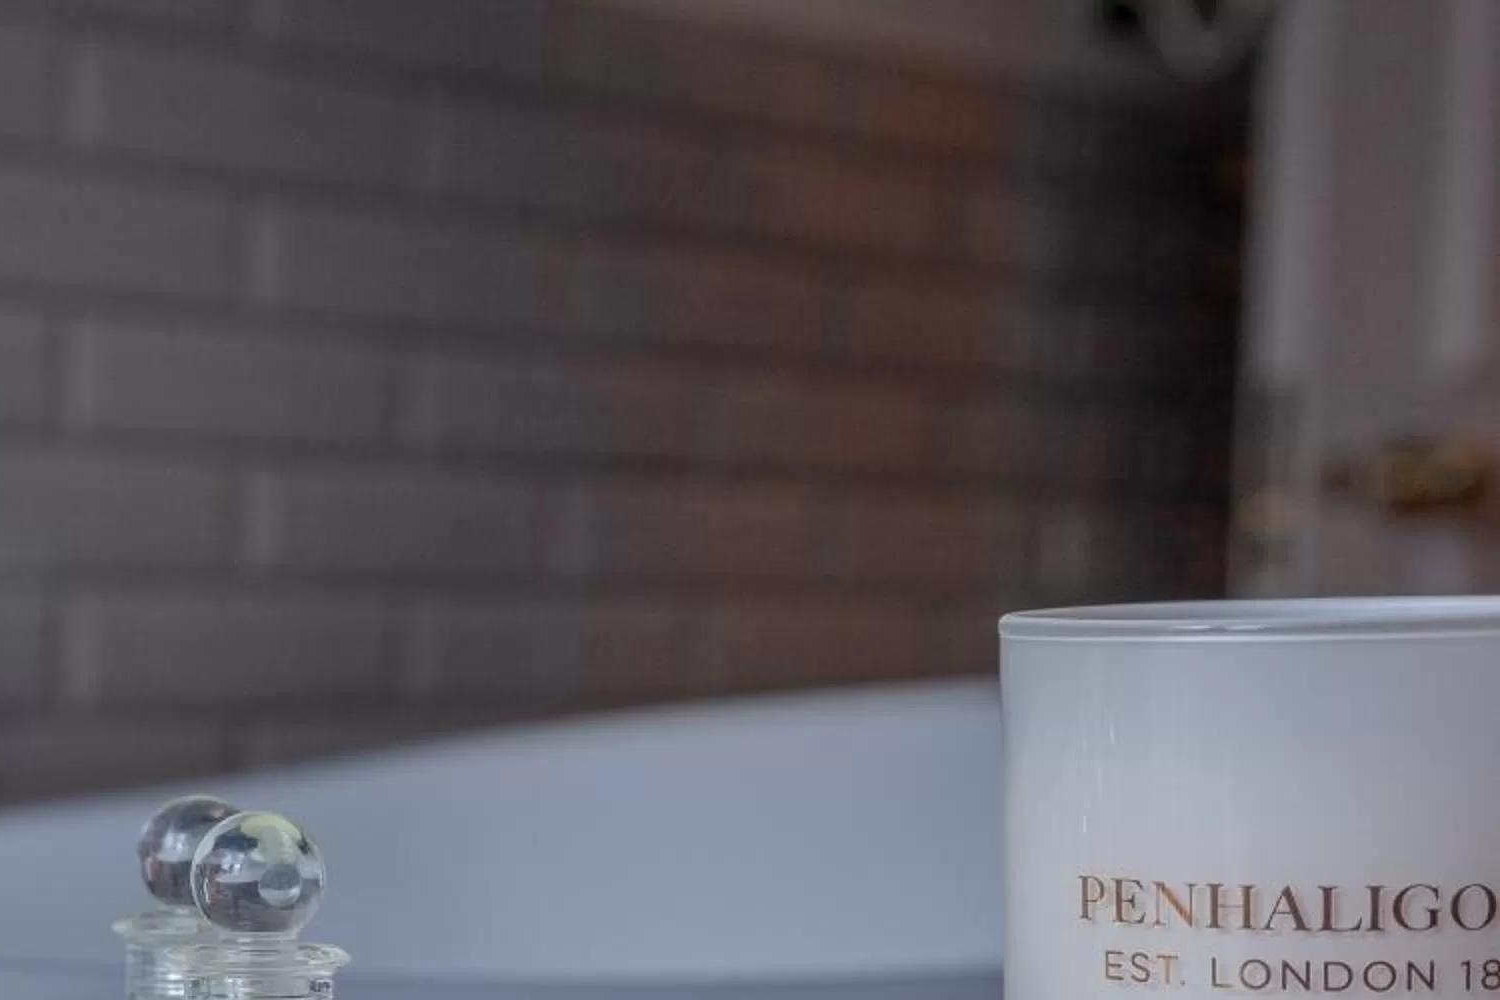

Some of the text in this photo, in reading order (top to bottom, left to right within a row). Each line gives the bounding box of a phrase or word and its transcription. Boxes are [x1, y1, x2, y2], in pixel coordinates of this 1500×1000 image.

[1078, 874, 1498, 933] PENHALIGO
[1104, 950, 1500, 992] EST. LONDON 18
